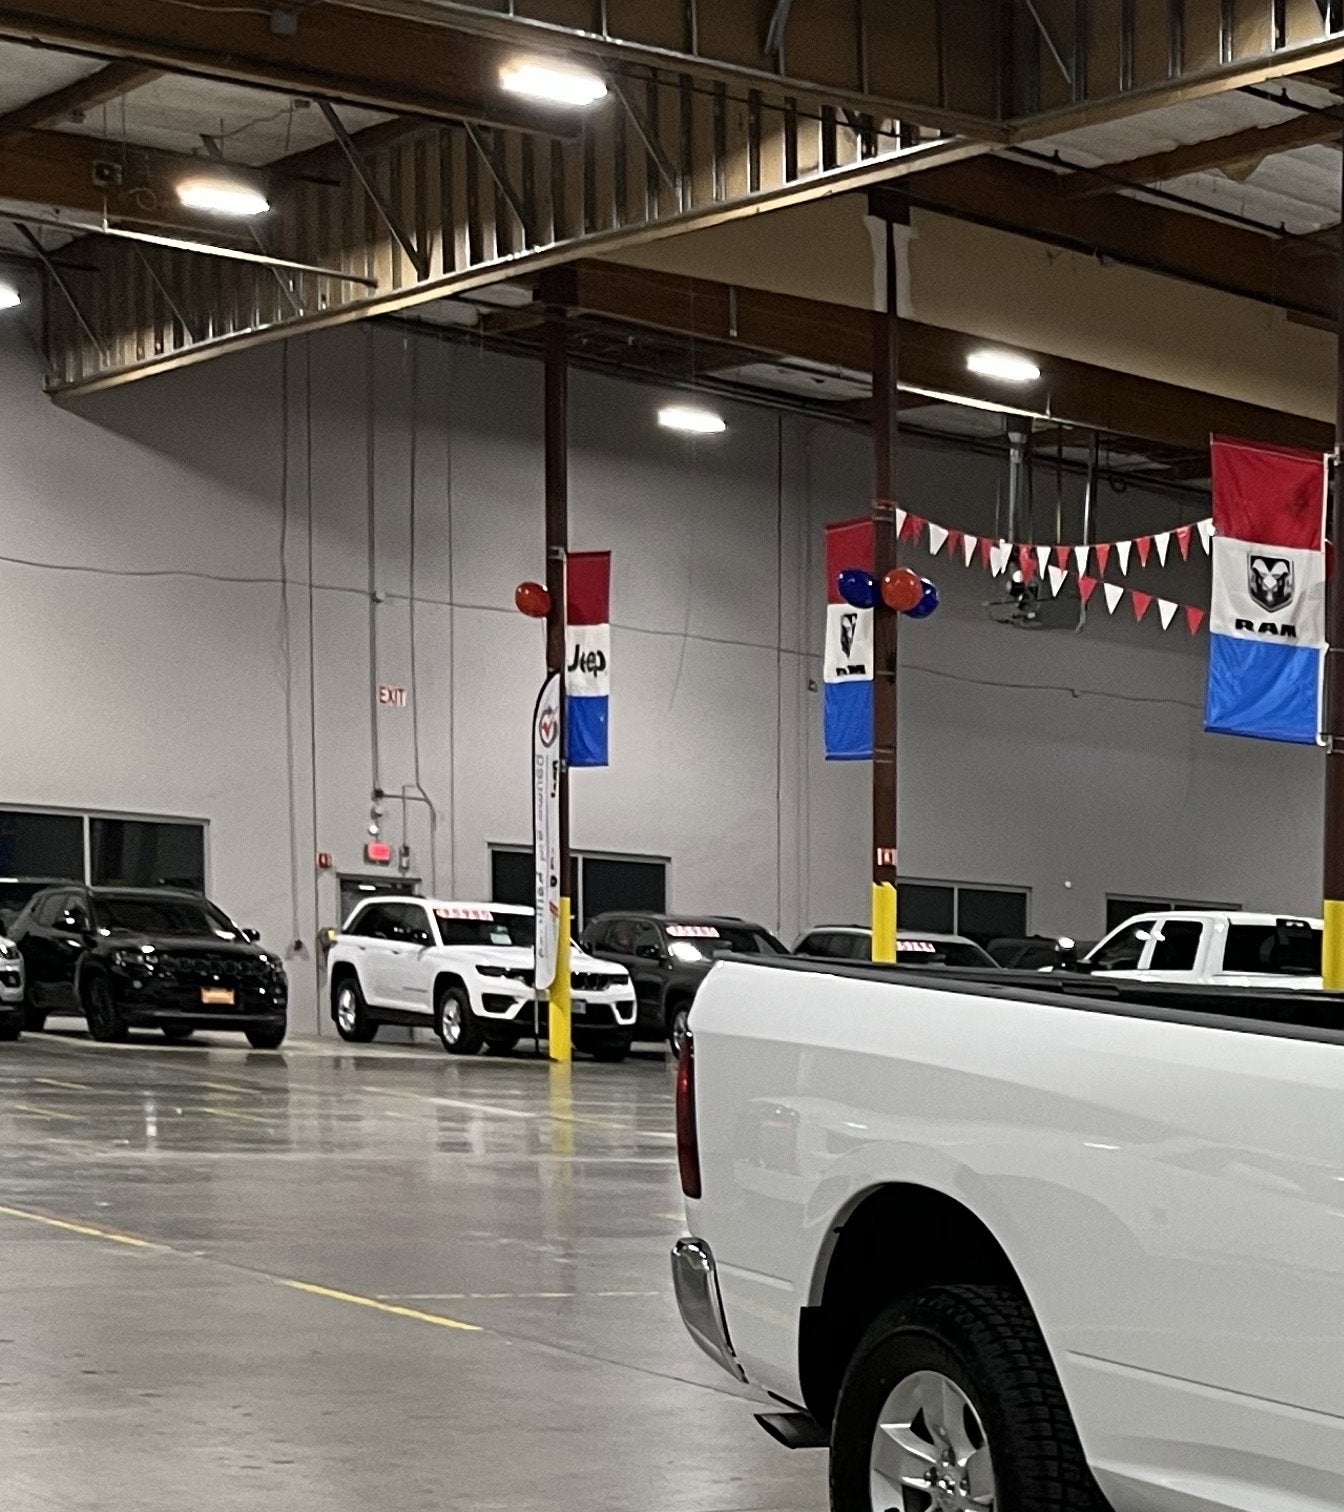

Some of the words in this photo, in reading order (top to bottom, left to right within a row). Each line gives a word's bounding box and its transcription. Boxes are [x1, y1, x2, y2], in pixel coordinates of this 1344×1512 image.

[1235, 618, 1297, 638] RAM
[567, 643, 607, 678] Jeep
[379, 686, 405, 705] EXIT
